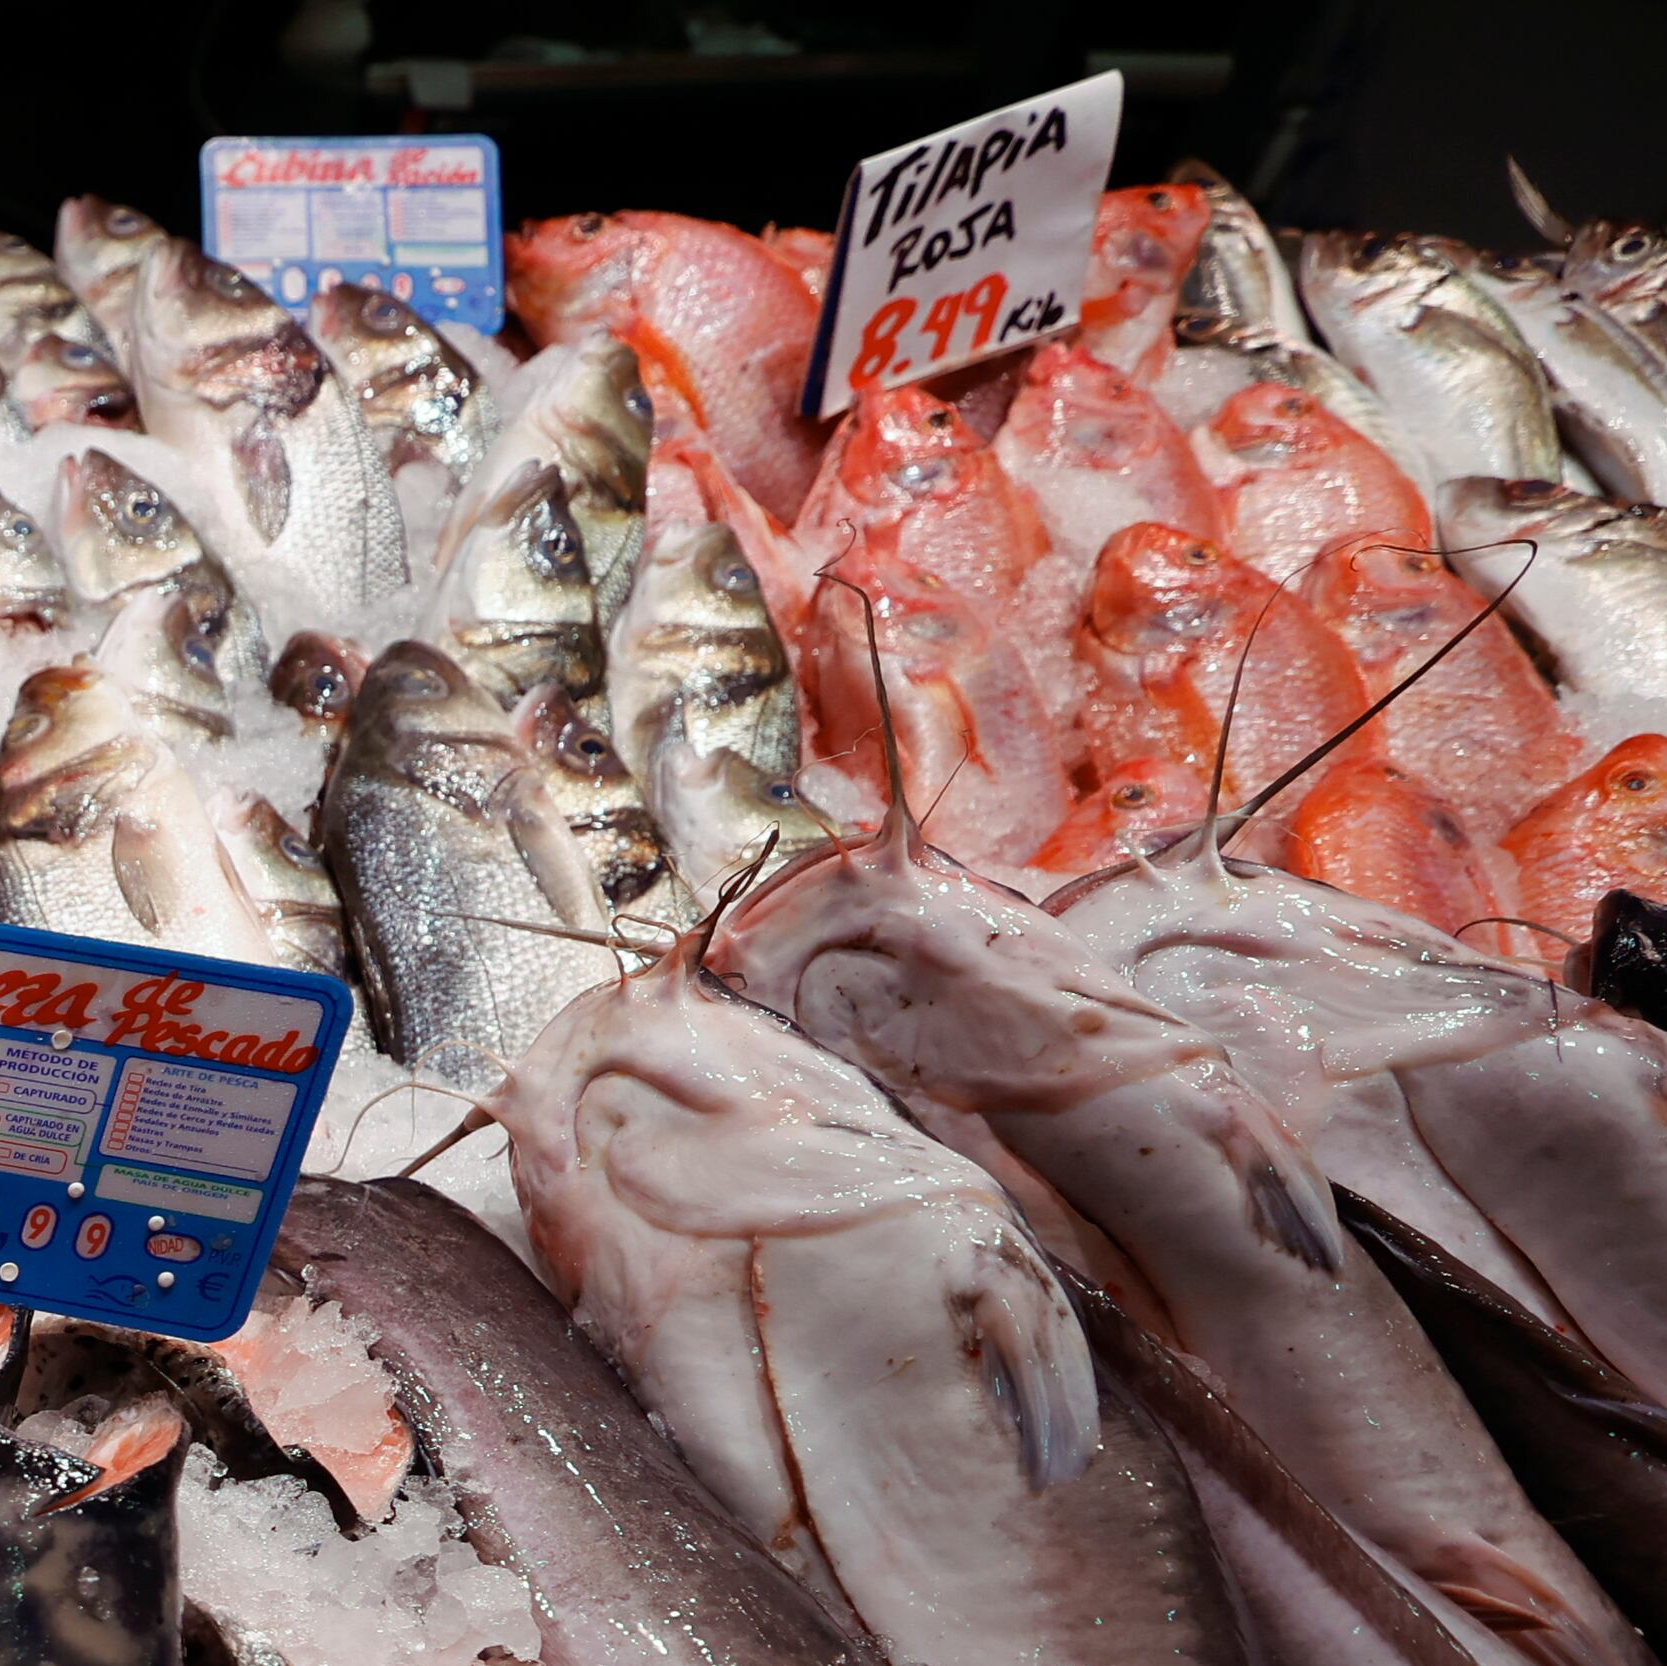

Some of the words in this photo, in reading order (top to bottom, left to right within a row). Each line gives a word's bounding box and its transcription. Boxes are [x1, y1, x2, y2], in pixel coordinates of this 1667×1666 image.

[121, 969, 206, 1017] de
[103, 1007, 321, 1074] Pescado
[6, 1047, 73, 1066] MÉTODO
[77, 1060, 99, 1071] DE
[163, 1067, 194, 1079] ARTE
[220, 1076, 259, 1089] PESCA
[13, 1086, 87, 1106] CAPTURADO
[5, 1114, 64, 1131] CAPTURADO
[66, 1124, 80, 1133] EN
[8, 1125, 36, 1136] AGUA
[39, 1130, 72, 1142] DULCE
[13, 1152, 26, 1160] DE
[114, 1168, 151, 1179] MASA
[153, 1173, 170, 1182] DE
[172, 1177, 207, 1189] AGUA
[211, 1184, 251, 1197] DULCE
